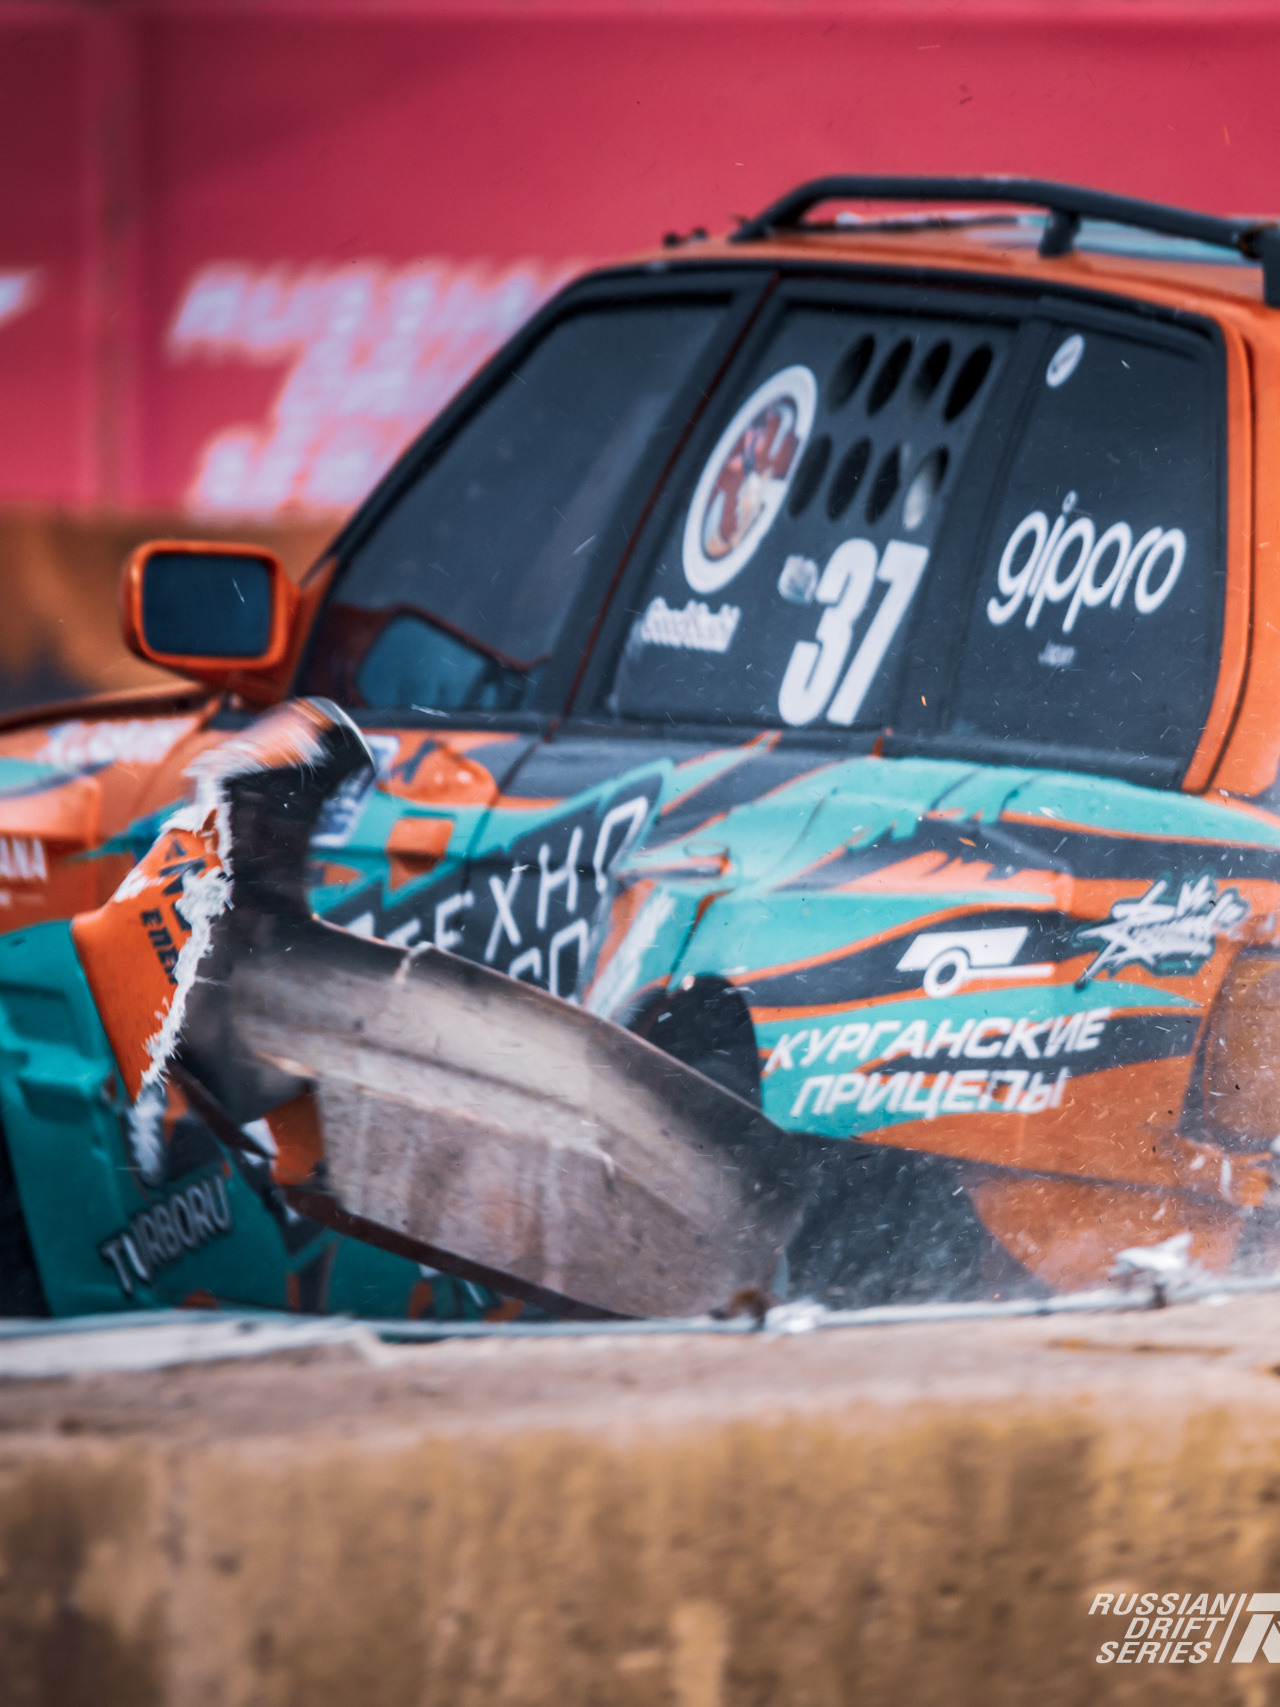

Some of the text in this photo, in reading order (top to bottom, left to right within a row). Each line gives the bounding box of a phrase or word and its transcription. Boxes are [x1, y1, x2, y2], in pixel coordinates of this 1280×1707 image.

[986, 489, 1187, 634] gippro
[778, 538, 929, 725] 37
[763, 1007, 1112, 1072] КУРГАНСКИЕ
[790, 1067, 1070, 1121] ПРИЦЕПЫ
